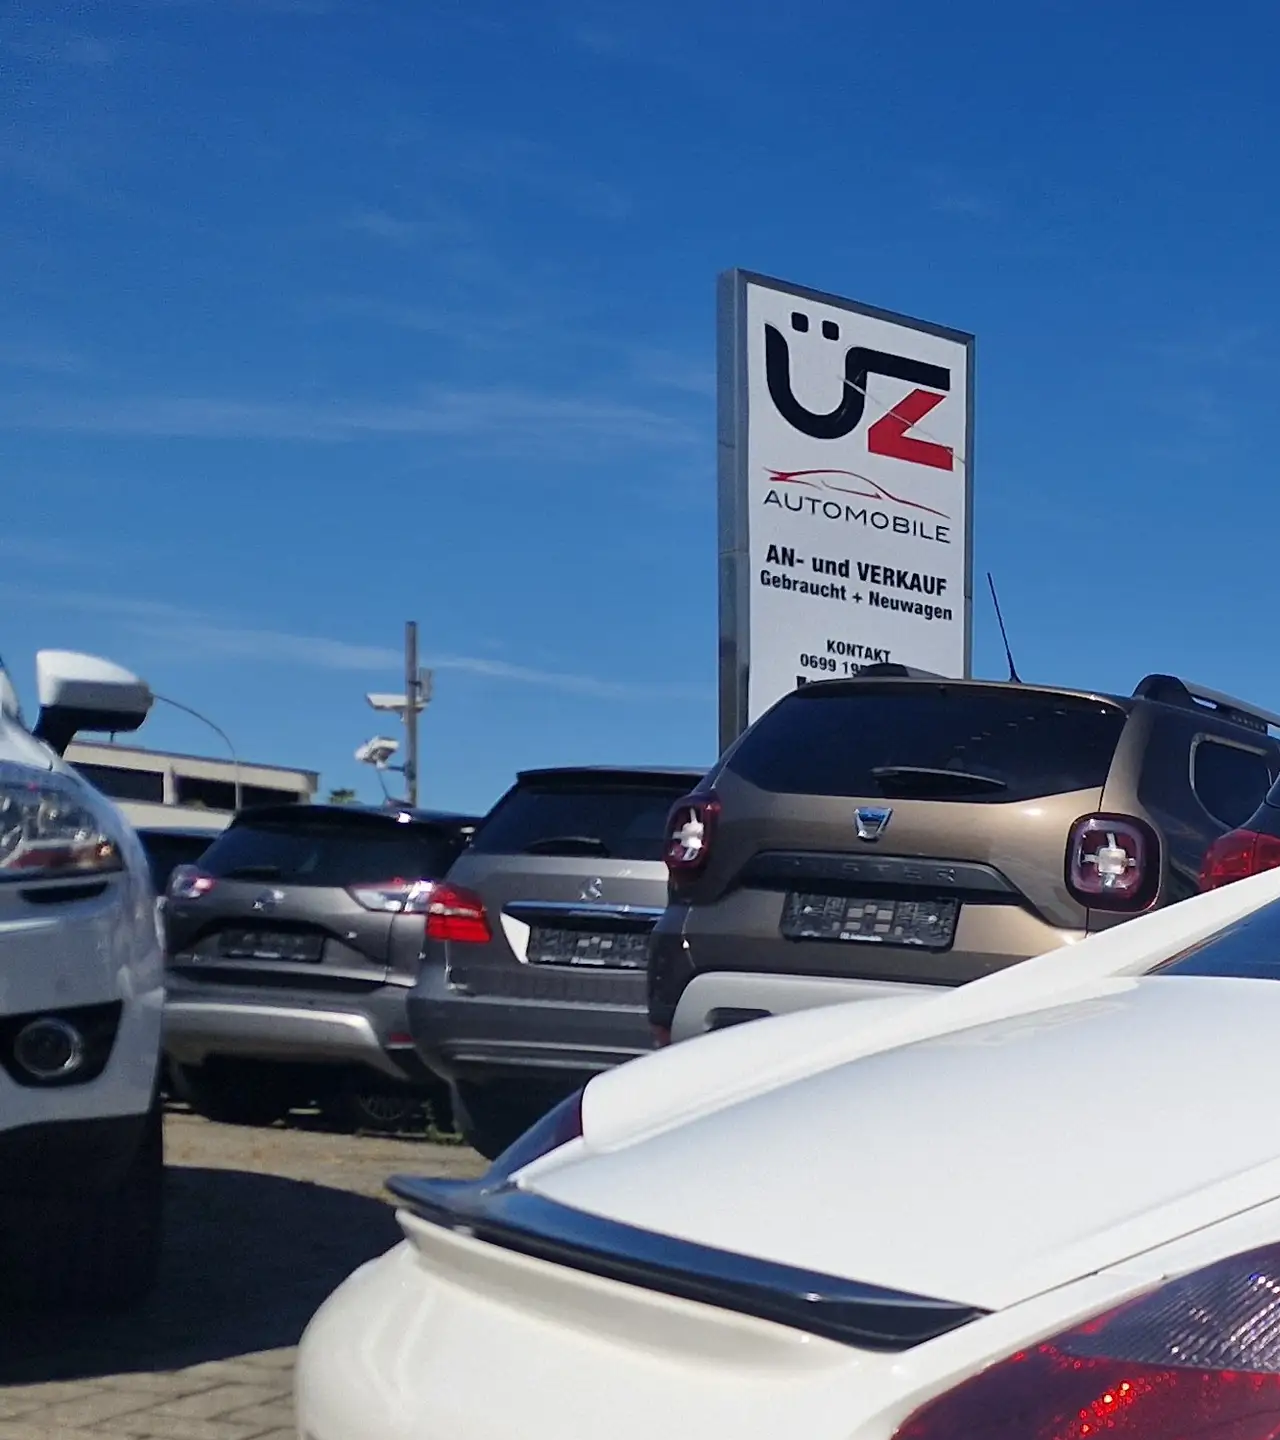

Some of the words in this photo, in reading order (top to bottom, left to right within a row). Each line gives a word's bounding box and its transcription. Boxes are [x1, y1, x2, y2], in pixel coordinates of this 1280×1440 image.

[763, 489, 951, 545] AUTOMOBILE
[760, 570, 847, 601] Gebraucht
[853, 593, 863, 604] +
[869, 590, 952, 621] Neuwagen
[766, 544, 804, 567] AN-
[812, 557, 849, 579] und
[857, 562, 947, 596] VERKAUF
[800, 653, 837, 673] 0699
[827, 639, 891, 664] KONTAKT
